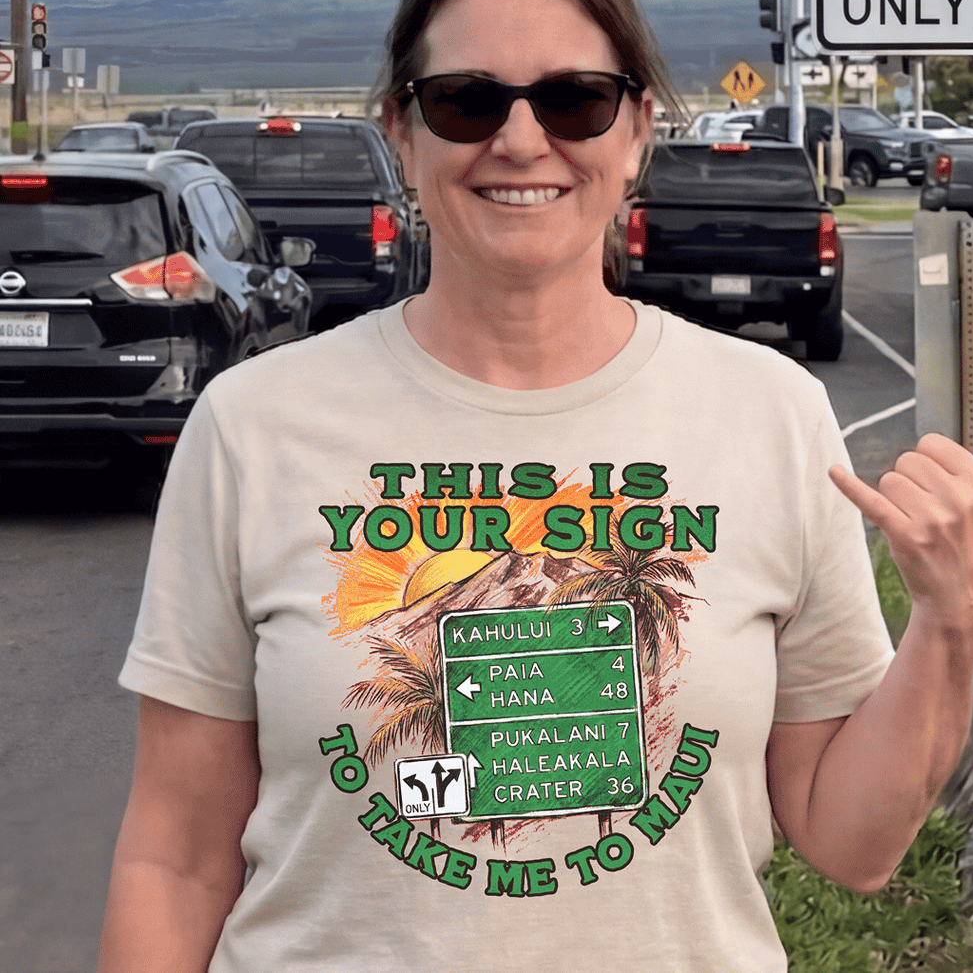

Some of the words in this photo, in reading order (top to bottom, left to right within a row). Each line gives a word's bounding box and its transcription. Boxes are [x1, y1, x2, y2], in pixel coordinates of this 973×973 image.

[370, 462, 557, 500] THIS
[589, 462, 668, 500] IS
[319, 504, 513, 552] YOUR
[541, 504, 719, 553] SIGN
[452, 620, 551, 644] KAHULUI
[570, 618, 584, 636] 3
[489, 662, 545, 682] PAIA
[611, 655, 625, 672] 4
[490, 688, 555, 708] HANA
[600, 682, 629, 700] 48
[491, 724, 606, 748] PUKALANI
[617, 722, 630, 740] 7
[492, 749, 632, 776] HALEAKALA
[494, 780, 583, 803] CRATER
[606, 776, 635, 795] 36
[318, 723, 369, 794] TO
[357, 791, 477, 890] TAKE
[484, 857, 558, 898] ME
[564, 832, 634, 886] TO
[628, 722, 719, 846] MAUI
[405, 802, 431, 814] ONLY
